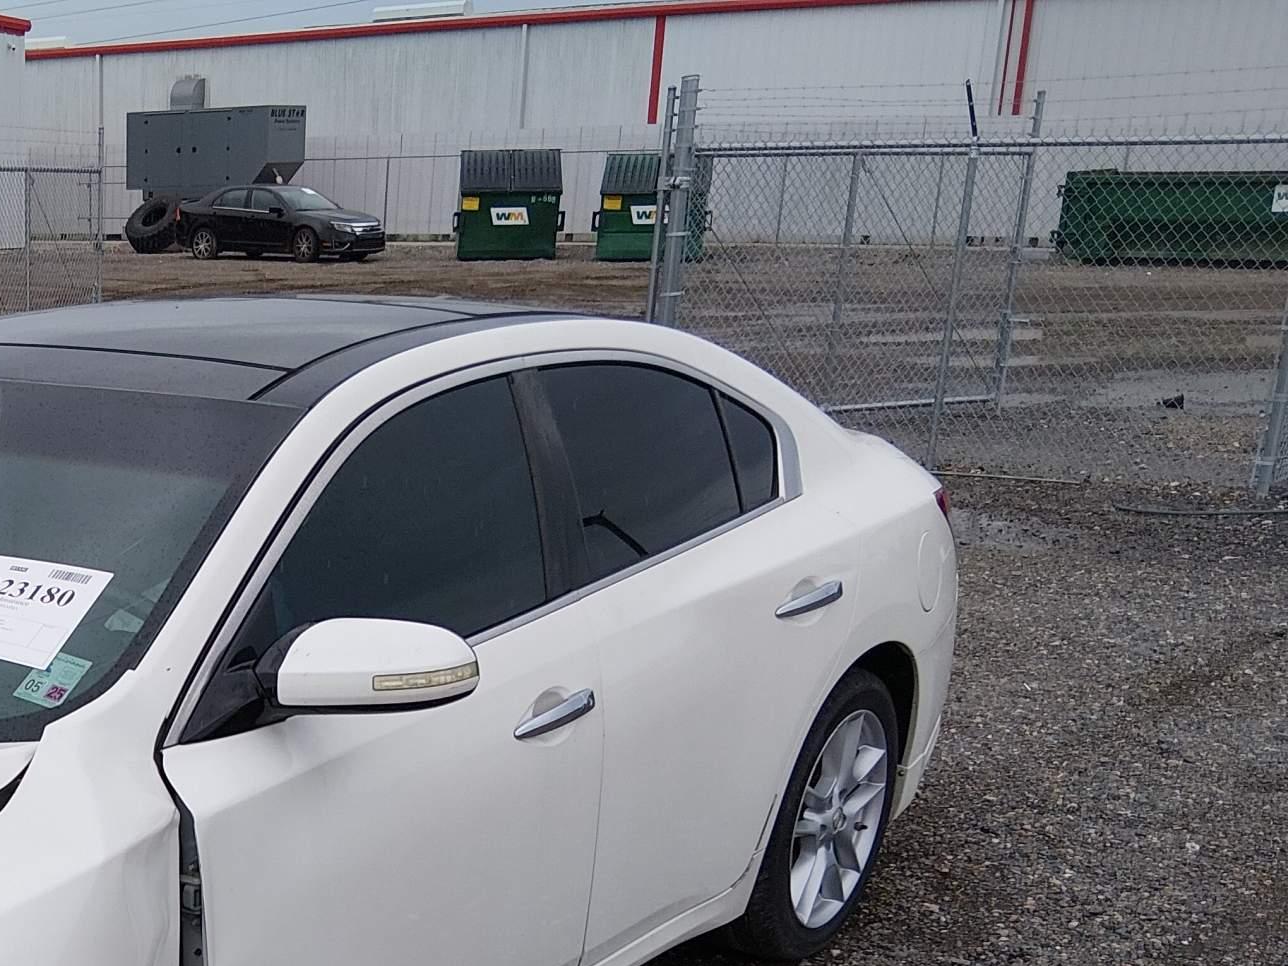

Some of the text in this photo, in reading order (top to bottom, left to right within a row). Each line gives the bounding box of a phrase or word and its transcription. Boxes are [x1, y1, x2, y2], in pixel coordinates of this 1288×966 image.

[496, 212, 523, 221] WM
[24, 679, 43, 693] 05
[46, 686, 67, 700] 25
